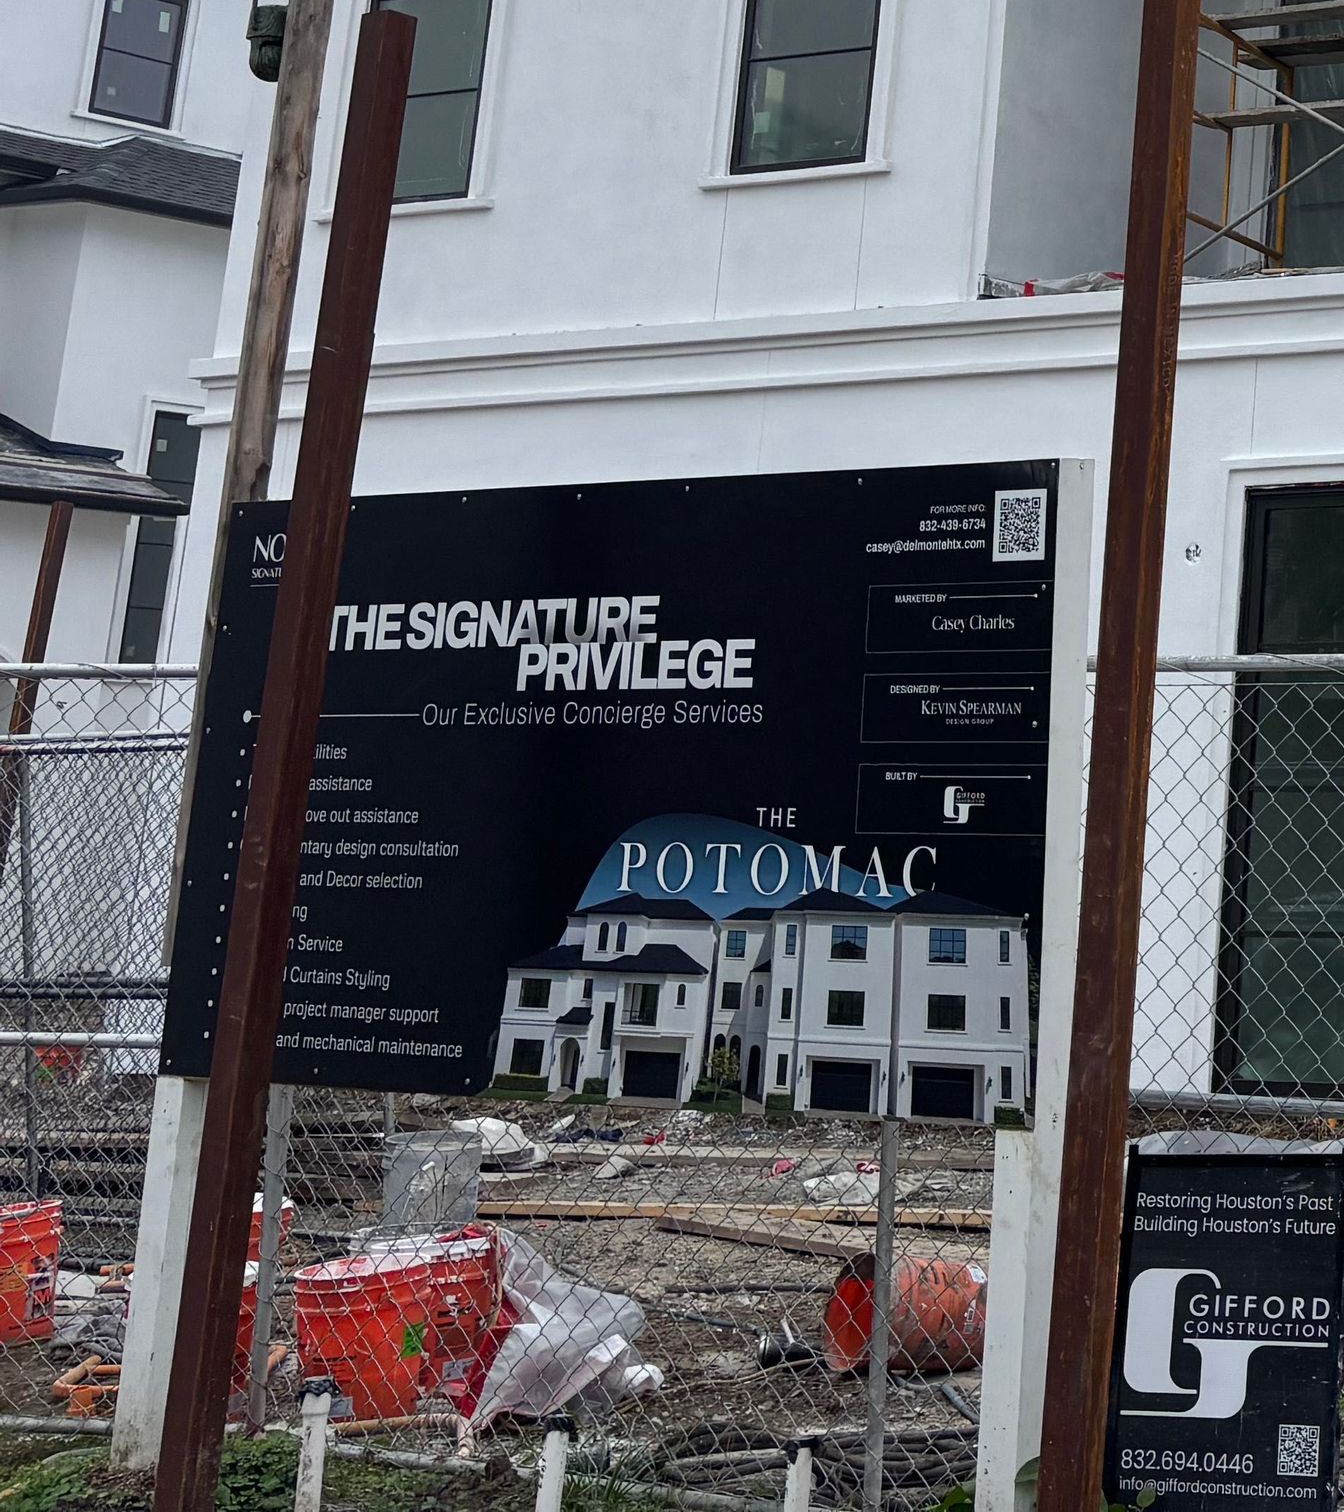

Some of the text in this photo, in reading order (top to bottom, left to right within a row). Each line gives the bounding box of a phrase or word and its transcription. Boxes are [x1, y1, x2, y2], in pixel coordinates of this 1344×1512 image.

[930, 503, 986, 514] FOR MORE INFO:
[865, 538, 986, 554] casey@delmontehtx.com
[895, 594, 948, 603] MARKETED BY
[329, 595, 660, 652] THE SIGNATURE
[931, 614, 1015, 633] Casey Charles
[516, 638, 756, 692] PRIVILEGE
[890, 685, 940, 694] DESIGNED BY
[422, 699, 763, 729] Our Exclusive Concierge Services
[921, 700, 1022, 715] KEVIN SPEARMAN
[315, 743, 348, 760] ilities
[308, 775, 373, 792] assistance
[885, 772, 918, 781] BUILT BY
[330, 809, 351, 823] out
[353, 808, 419, 824] assistance
[756, 807, 797, 828] THE
[335, 838, 377, 859] design
[379, 841, 460, 857] consultation
[299, 871, 423, 889] and Decor selection
[616, 841, 938, 898] POTOMAC
[297, 934, 343, 952] Service
[290, 966, 343, 984] Curtains
[345, 968, 391, 990] Styling
[283, 1001, 440, 1025] project manager support
[275, 1032, 463, 1058] and mechanical maintenance
[1136, 1192, 1212, 1213] Restoring
[1299, 1195, 1334, 1211] Past
[1133, 1215, 1198, 1237] Building
[1285, 1219, 1337, 1235] Future
[1189, 1294, 1331, 1320] GIFFORD
[1183, 1320, 1330, 1338] CONSTRUCTION
[1120, 1449, 1254, 1474] 832.694.0446
[1119, 1476, 1317, 1500] info@giffordconstruction.com
